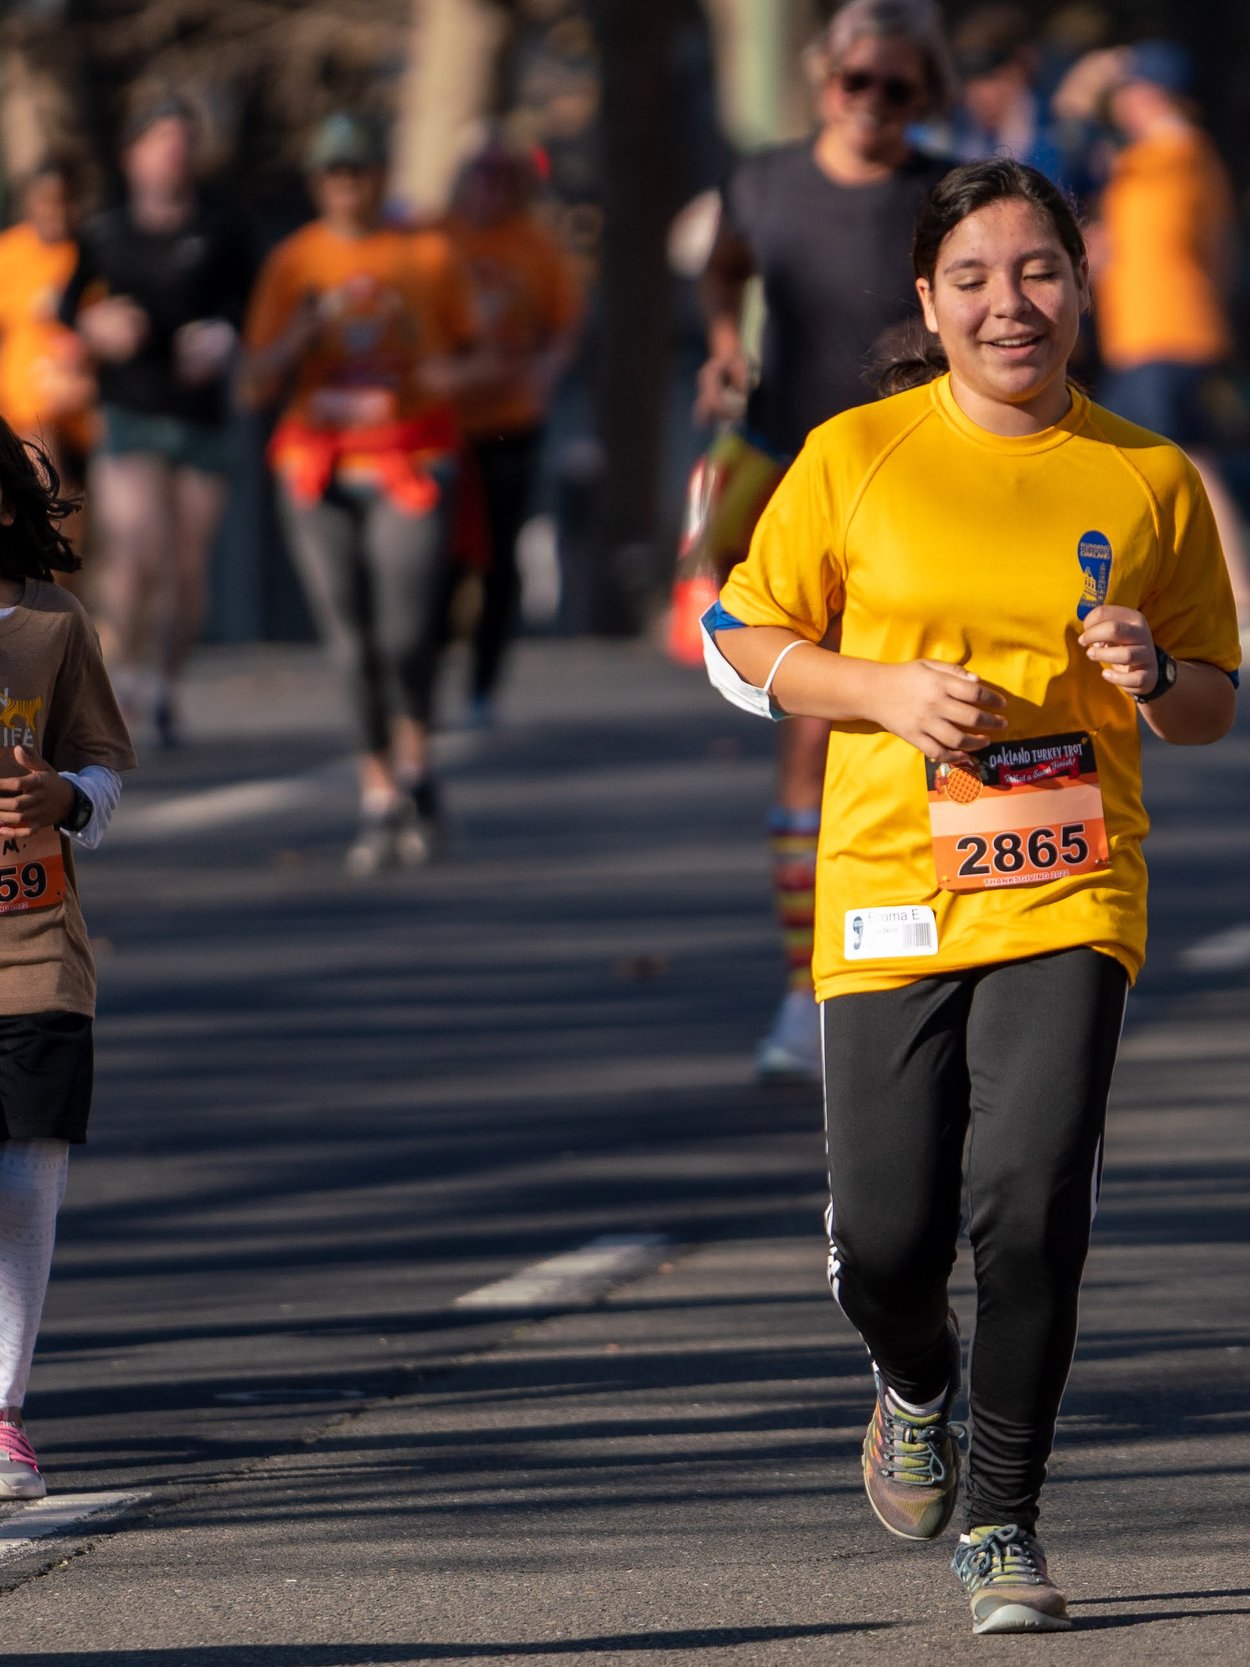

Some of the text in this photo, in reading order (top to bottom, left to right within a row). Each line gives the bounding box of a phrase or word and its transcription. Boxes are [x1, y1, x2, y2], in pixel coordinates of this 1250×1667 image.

[989, 743, 1083, 769] OAKLAND TURKEY TROT
[1003, 773, 1027, 784] What
[1051, 758, 1077, 771] Finish!
[956, 822, 1089, 877] 2865
[984, 871, 1050, 887] THANKSGIVING
